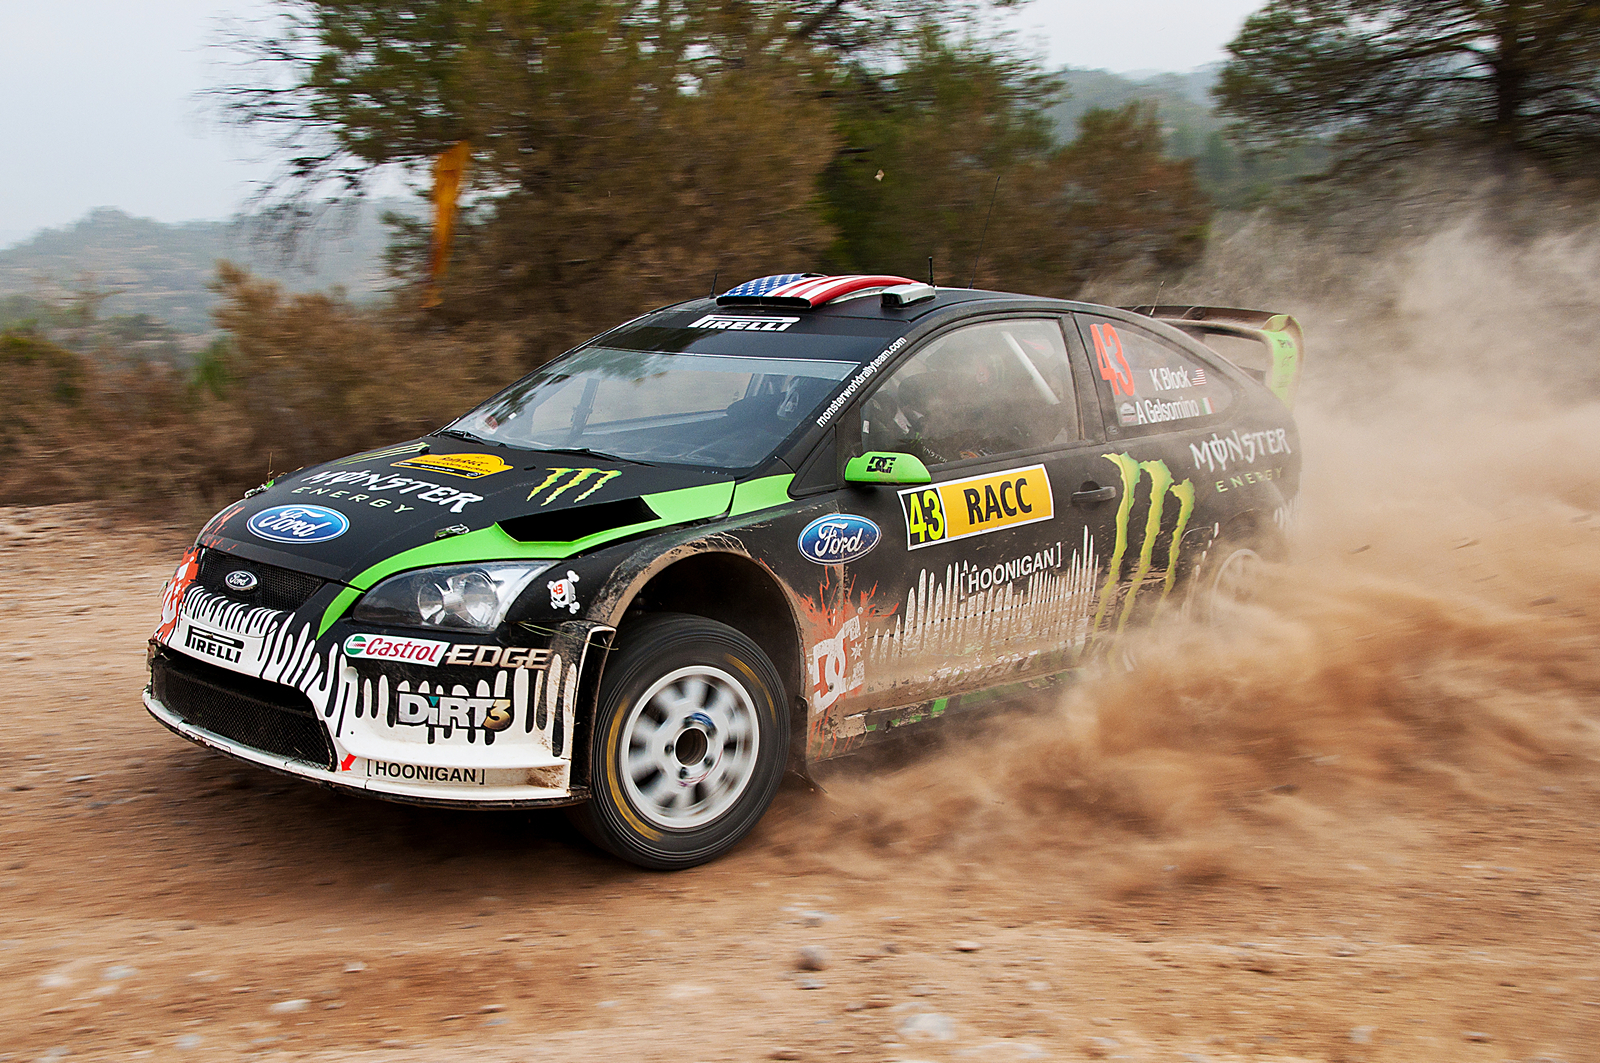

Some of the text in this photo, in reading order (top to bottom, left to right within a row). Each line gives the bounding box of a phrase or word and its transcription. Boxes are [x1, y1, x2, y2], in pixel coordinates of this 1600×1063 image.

[687, 314, 800, 332] PIRELLI
[1089, 322, 1135, 397] 43
[815, 336, 907, 428] monsterworldrallyteam.com
[1149, 366, 1192, 391] K Block
[1135, 396, 1200, 425] A Gelsomino
[291, 486, 415, 513] ENERGY
[909, 478, 1033, 543] 43 RACC
[258, 508, 333, 537] Ford
[814, 522, 864, 557] Ford
[229, 573, 250, 586] Ford
[553, 584, 564, 594] 43
[184, 625, 245, 664] PIRELLI
[365, 637, 552, 670] Castrol EDGE
